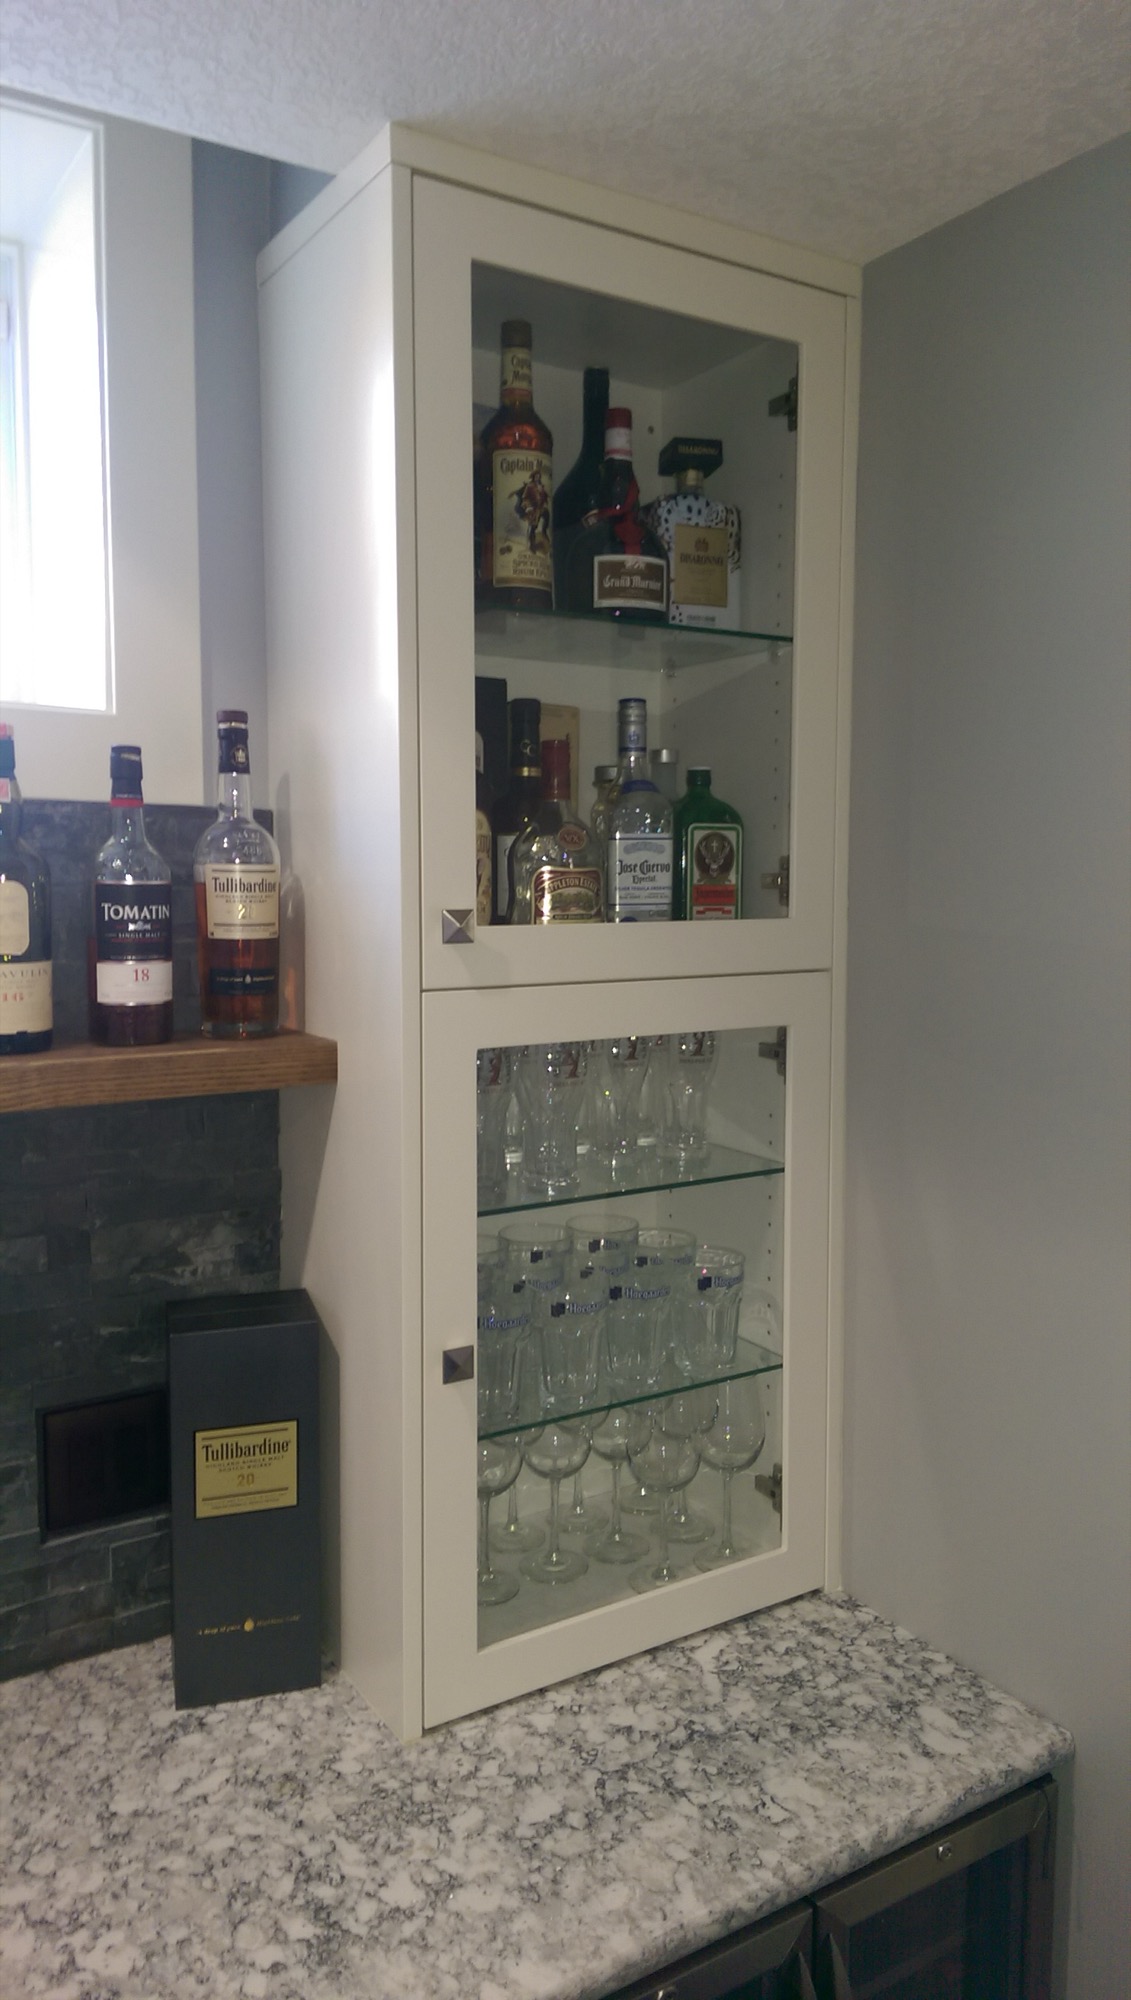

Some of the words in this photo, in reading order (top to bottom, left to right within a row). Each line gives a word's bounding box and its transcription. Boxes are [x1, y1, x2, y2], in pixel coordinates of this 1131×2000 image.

[500, 457, 534, 475] Captain
[680, 553, 723, 567] DISARONNO
[602, 574, 630, 589] Grand
[631, 575, 661, 591] Marnier
[617, 859, 639, 876] Jose
[639, 859, 671, 875] Cuervo
[101, 902, 170, 921] TOMATIN
[133, 967, 150, 982] 18
[202, 1438, 290, 1463] Tullibardine
[236, 1473, 255, 1487] 20
